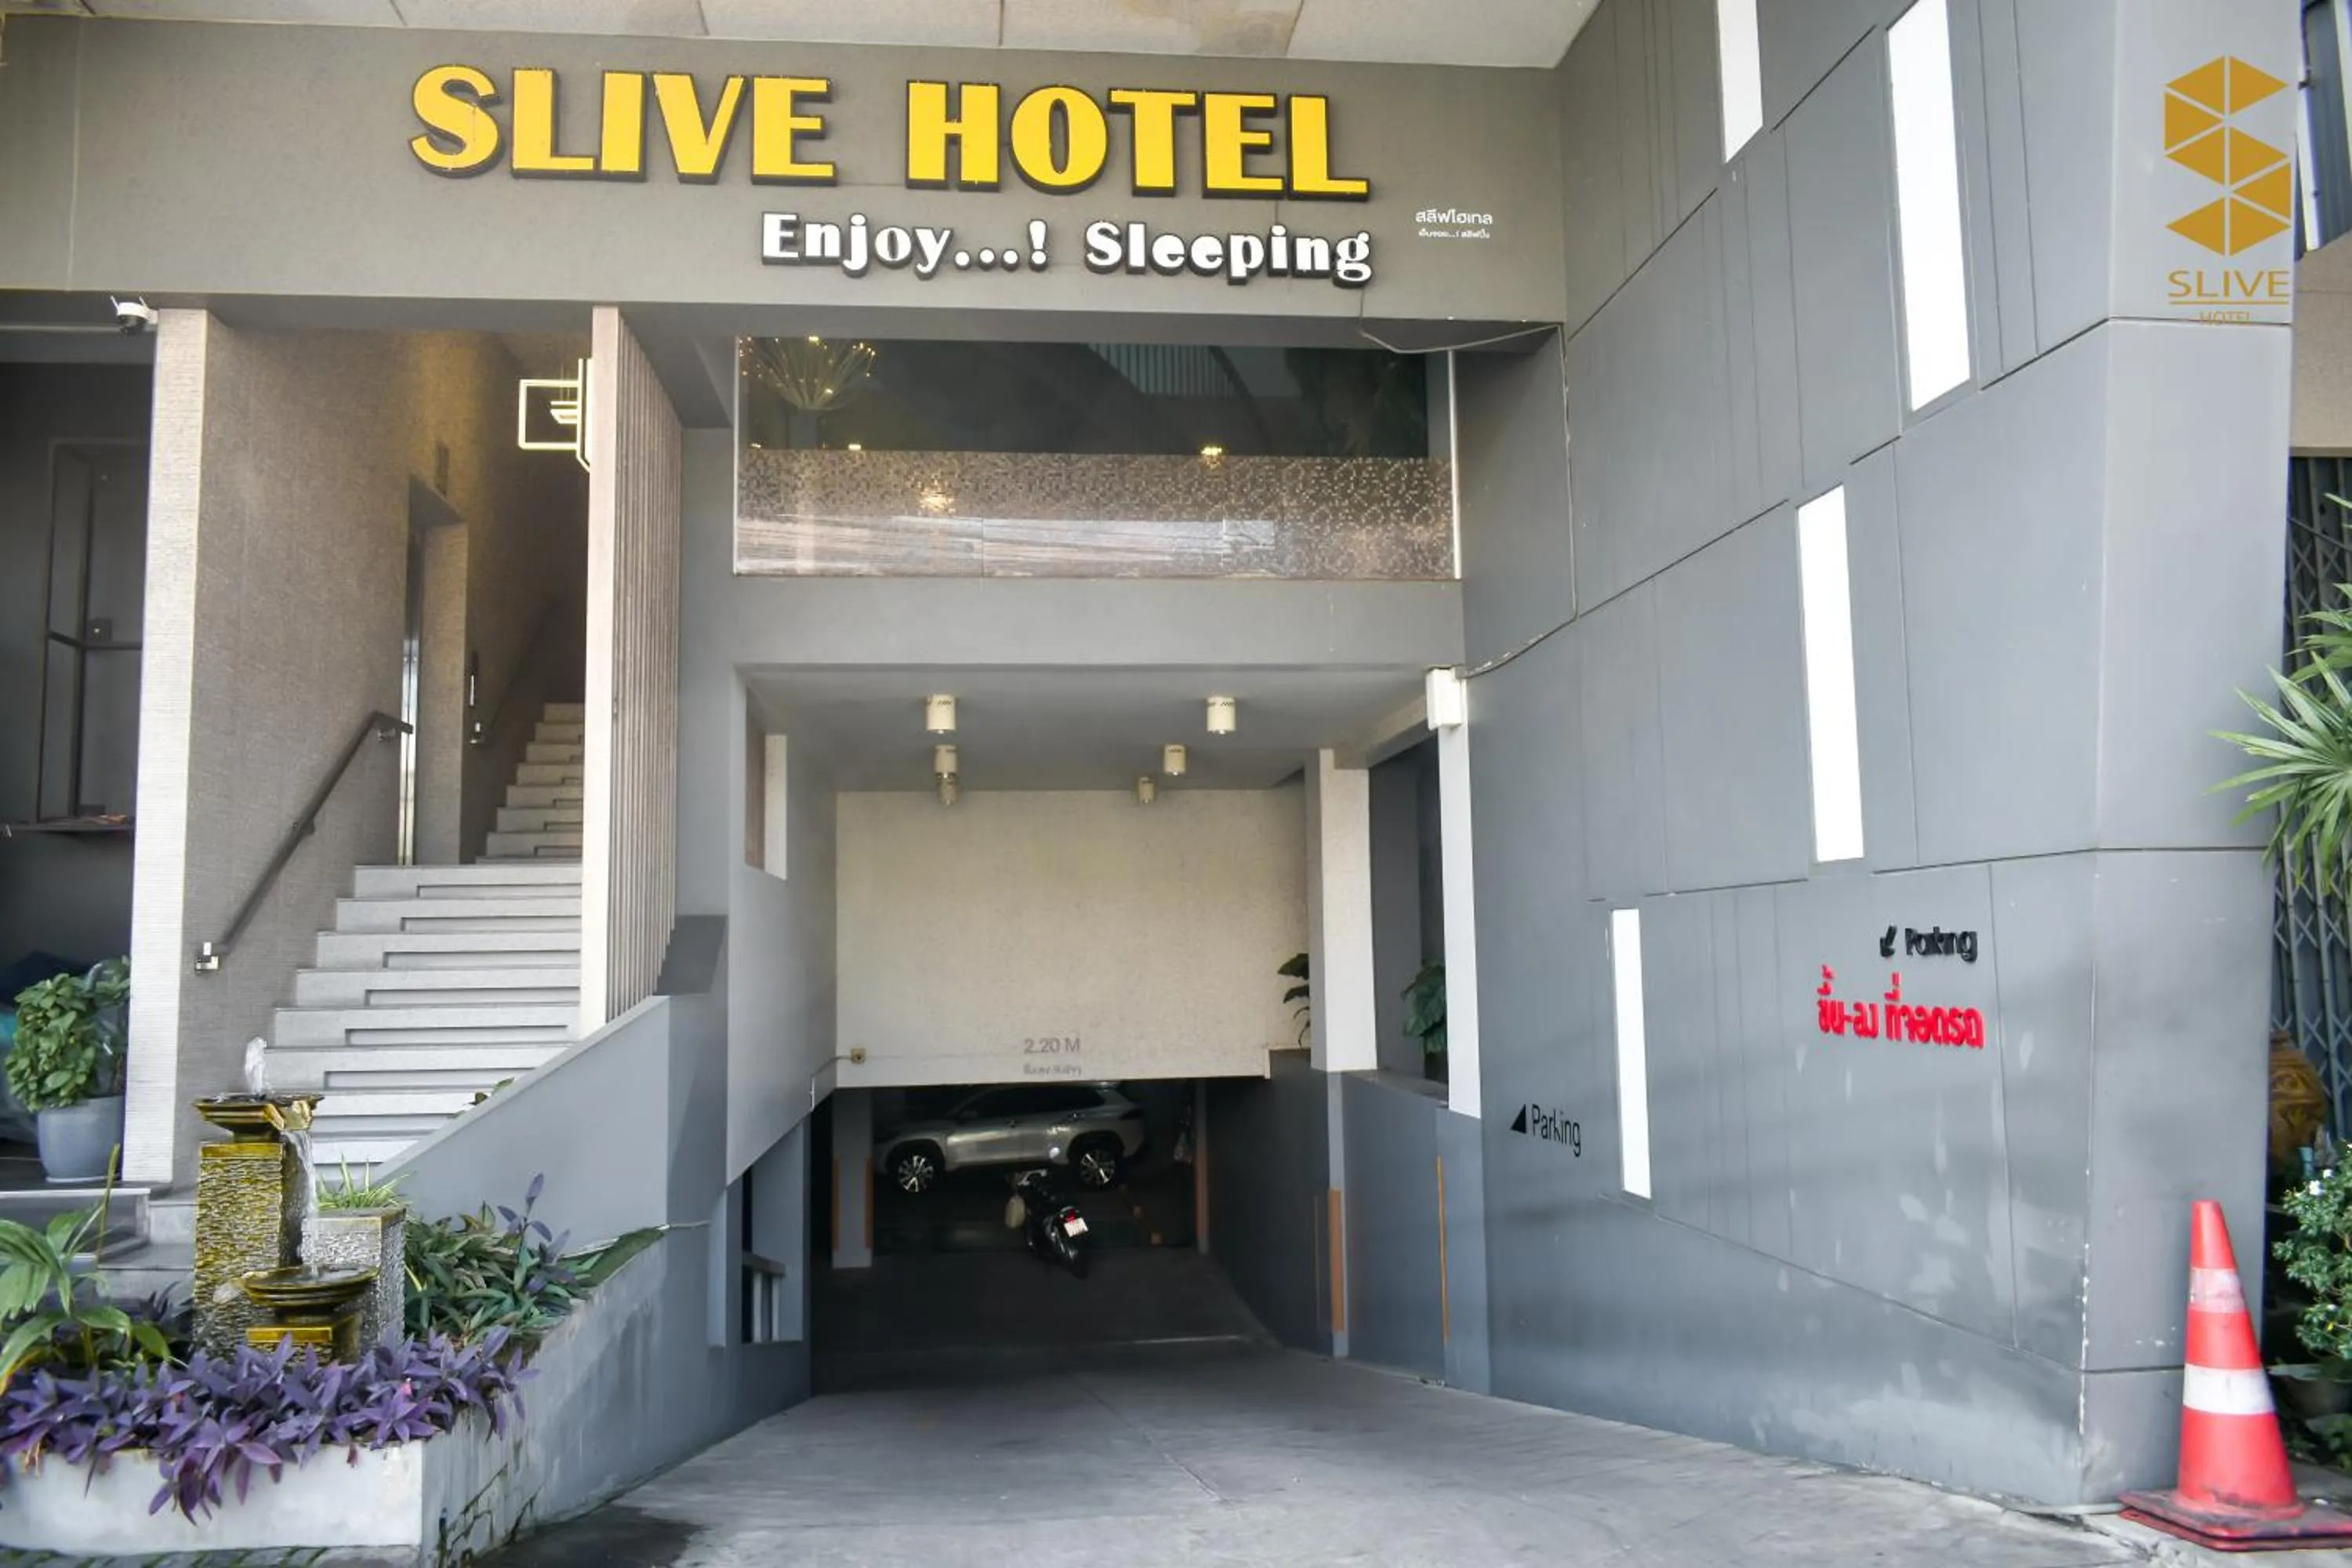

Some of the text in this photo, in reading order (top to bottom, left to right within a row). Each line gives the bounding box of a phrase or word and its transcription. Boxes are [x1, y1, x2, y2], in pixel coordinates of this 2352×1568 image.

[410, 64, 1370, 198] SLIVE HOTEL
[761, 212, 1373, 287] Enjoy...! Sleeping
[1065, 1036, 1080, 1052] M
[1531, 1103, 1581, 1158] Parking
